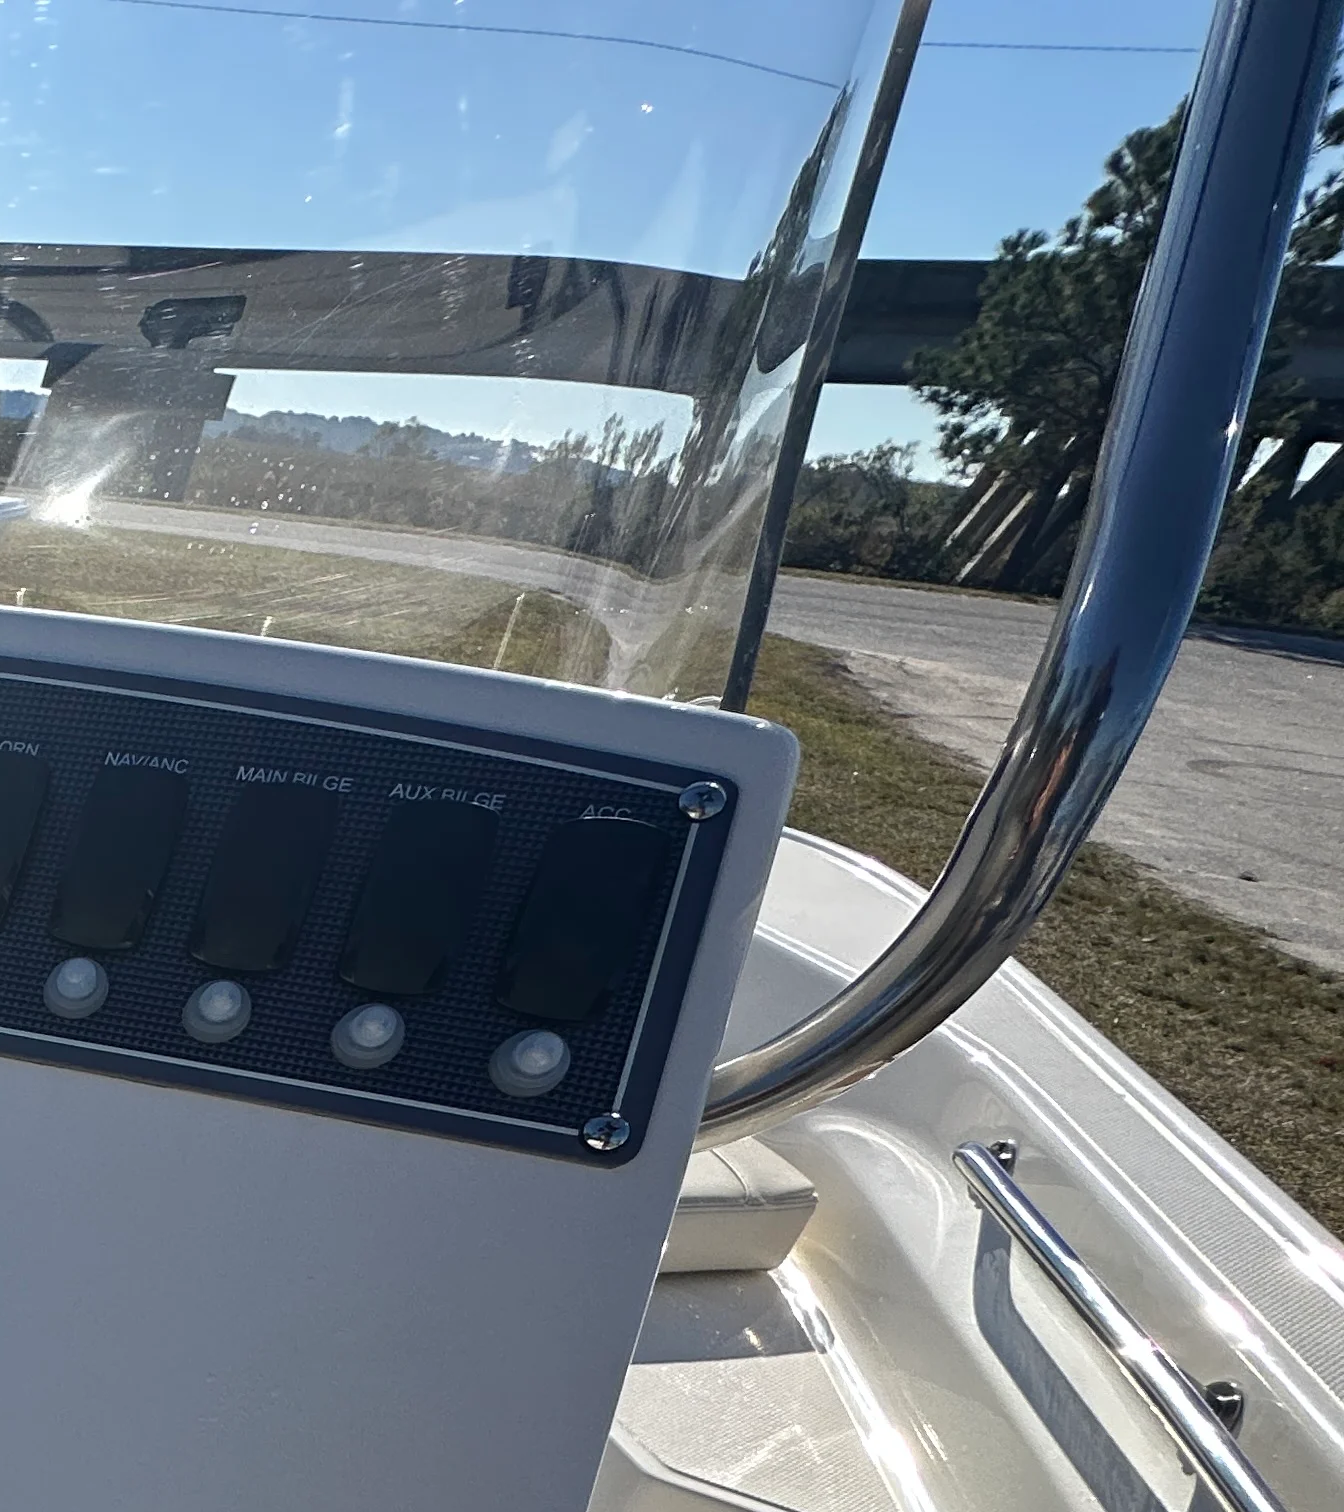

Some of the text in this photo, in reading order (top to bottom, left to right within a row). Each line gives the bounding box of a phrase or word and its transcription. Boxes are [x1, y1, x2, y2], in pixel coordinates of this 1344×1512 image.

[104, 751, 189, 774] NAV/ANC
[235, 766, 287, 784] MAIN
[389, 783, 433, 800] AUX
